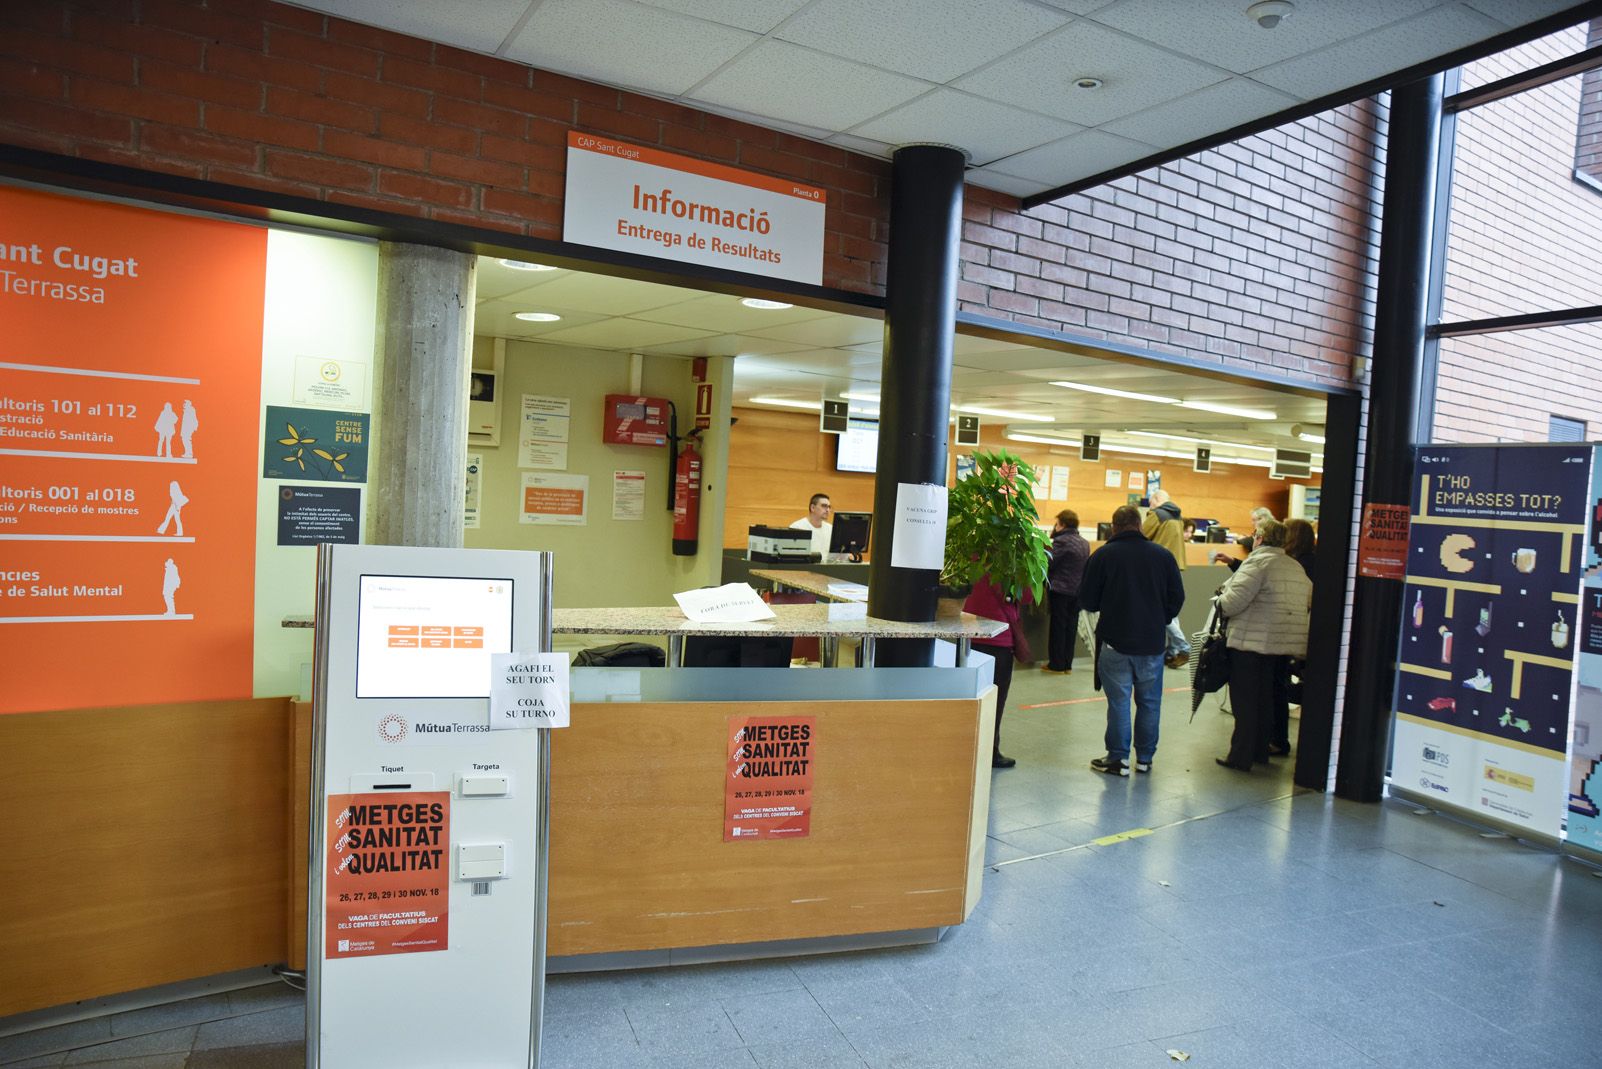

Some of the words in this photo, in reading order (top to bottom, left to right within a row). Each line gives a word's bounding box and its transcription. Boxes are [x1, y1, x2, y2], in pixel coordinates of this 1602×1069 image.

[577, 136, 595, 147] CAP
[596, 140, 614, 152] Sant
[616, 145, 640, 158] Cugat
[793, 187, 812, 198] Planta
[813, 190, 820, 199] 0
[633, 184, 770, 235] Informació
[617, 219, 682, 248] Entrega
[687, 232, 706, 250] de
[711, 236, 781, 264] Resultats
[53, 246, 138, 278] Cugat
[0, 396, 44, 412] ltoris
[51, 399, 81, 415] 101
[88, 404, 100, 416] al
[106, 404, 137, 418] 112
[834, 404, 838, 414] 1
[336, 420, 362, 428] CENTRE
[966, 418, 972, 428] 2
[60, 430, 114, 443] Sanitària
[336, 426, 362, 434] SENSE
[335, 433, 362, 444] FUM
[1089, 438, 1094, 446] 3
[1437, 474, 1470, 489] T'HO
[48, 486, 79, 500] 001
[86, 490, 98, 501] al
[102, 488, 135, 502] 018
[1436, 491, 1515, 508] EMPASSES
[1520, 494, 1562, 510] TOT?
[18, 504, 26, 513] /
[29, 503, 78, 515] Recepció
[82, 505, 94, 514] de
[98, 506, 139, 515] mostres
[8, 586, 26, 597] de
[30, 586, 68, 597] Salut
[73, 585, 122, 597] Mental
[508, 664, 540, 673] AGAFI
[542, 664, 554, 673] EL
[506, 676, 526, 684] SEU
[527, 676, 556, 684] TORN
[518, 698, 544, 708] COJA
[506, 710, 519, 718] SU
[521, 709, 556, 718] TURNO
[744, 724, 810, 742] METGES
[742, 742, 810, 758] SANITAT
[472, 764, 500, 772] Targeta
[742, 760, 808, 778] QUALITAT
[349, 802, 444, 826] METGES
[348, 826, 443, 850] SANITAT
[348, 850, 443, 875] QUALITAT
[340, 893, 352, 902] 26,
[354, 892, 366, 901] 27,
[368, 892, 380, 900] 28,
[398, 890, 407, 898] 30
[409, 889, 428, 897] NOV.
[379, 911, 426, 919] FACULTATIUS
